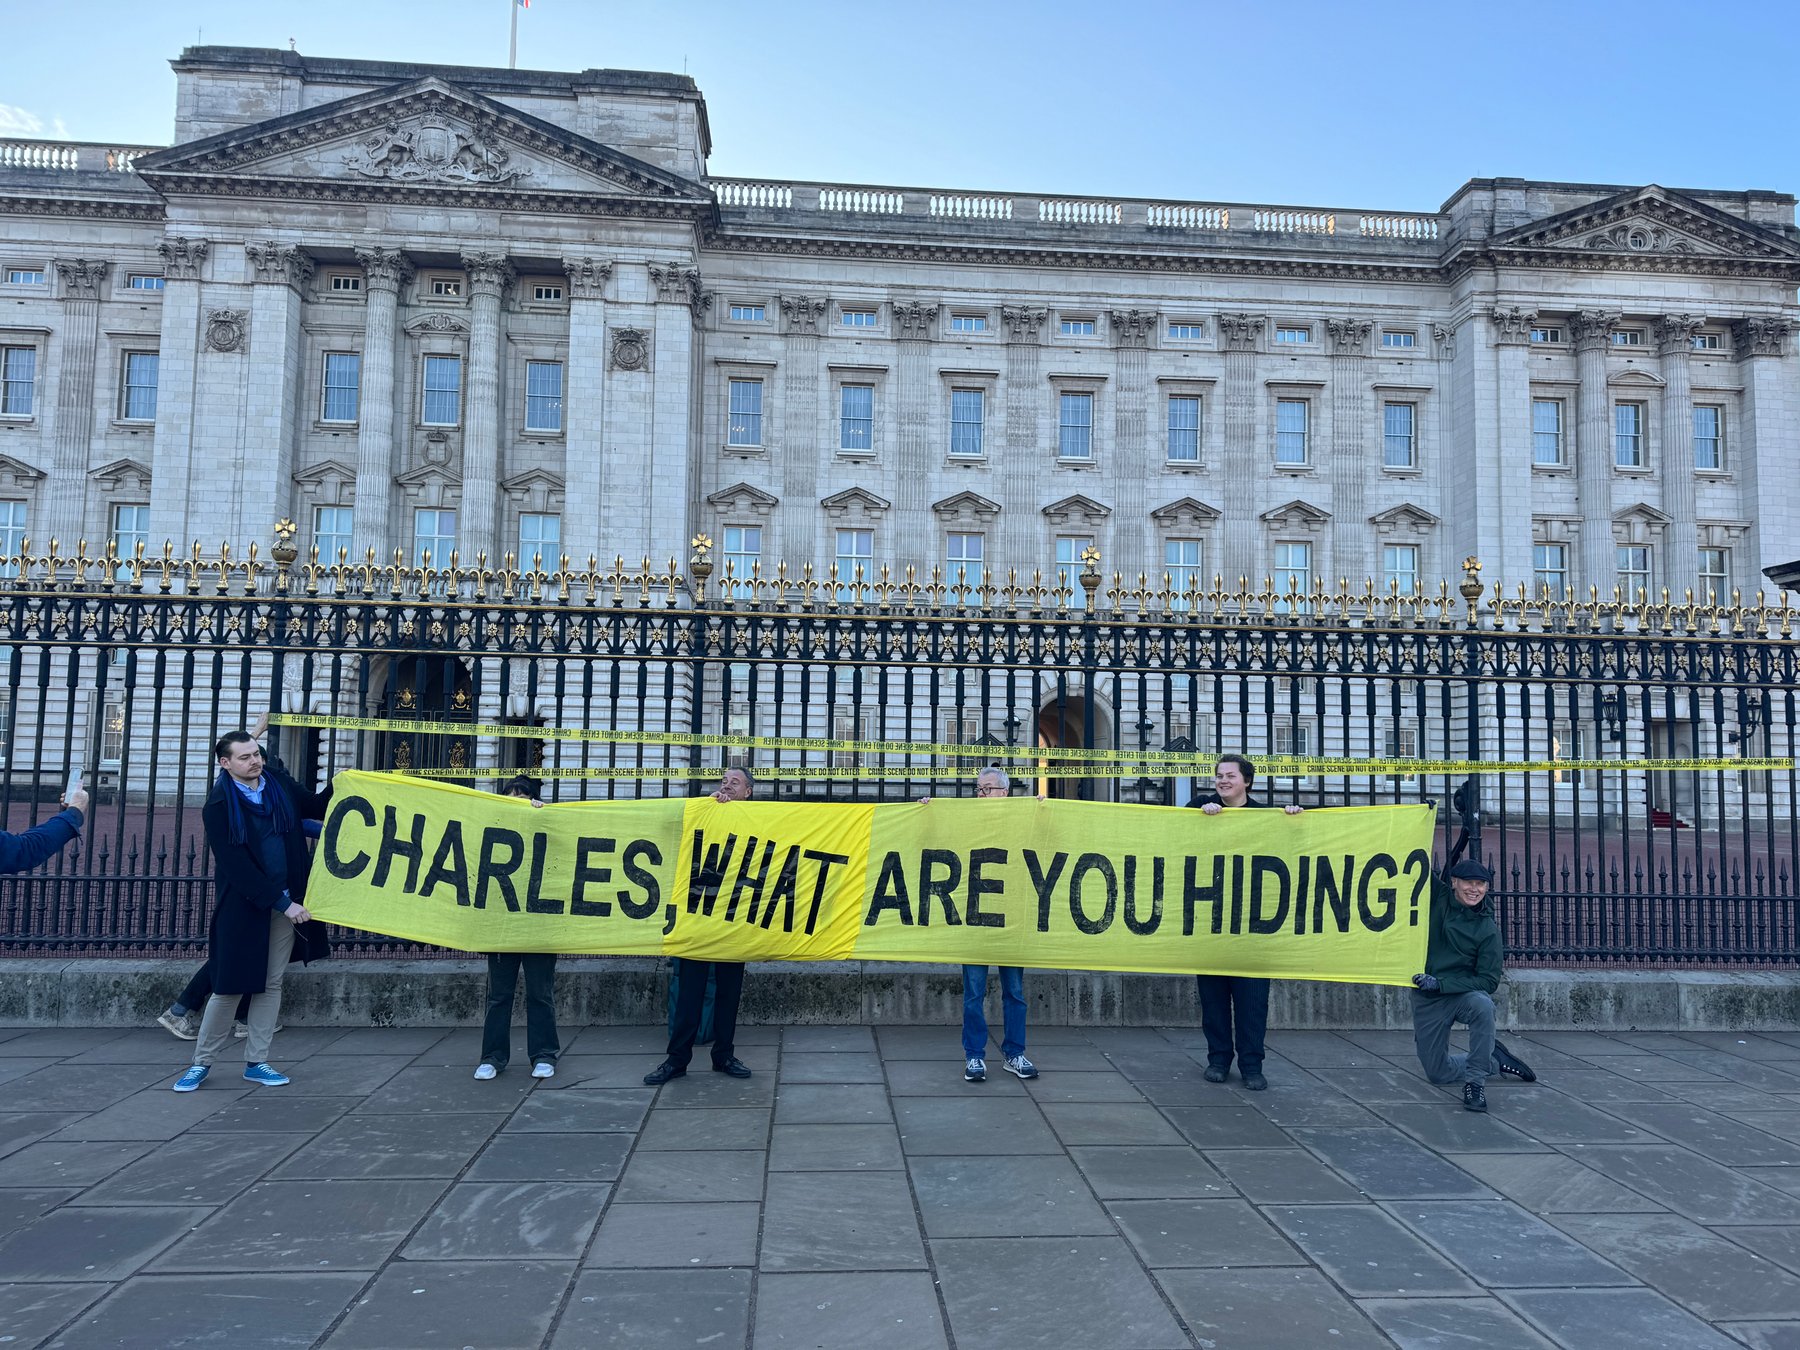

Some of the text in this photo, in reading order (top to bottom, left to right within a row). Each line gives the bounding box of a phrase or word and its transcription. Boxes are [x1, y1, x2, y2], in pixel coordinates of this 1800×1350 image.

[324, 795, 1429, 936] CHARLES, WHAT ARE YOU HIDING?
